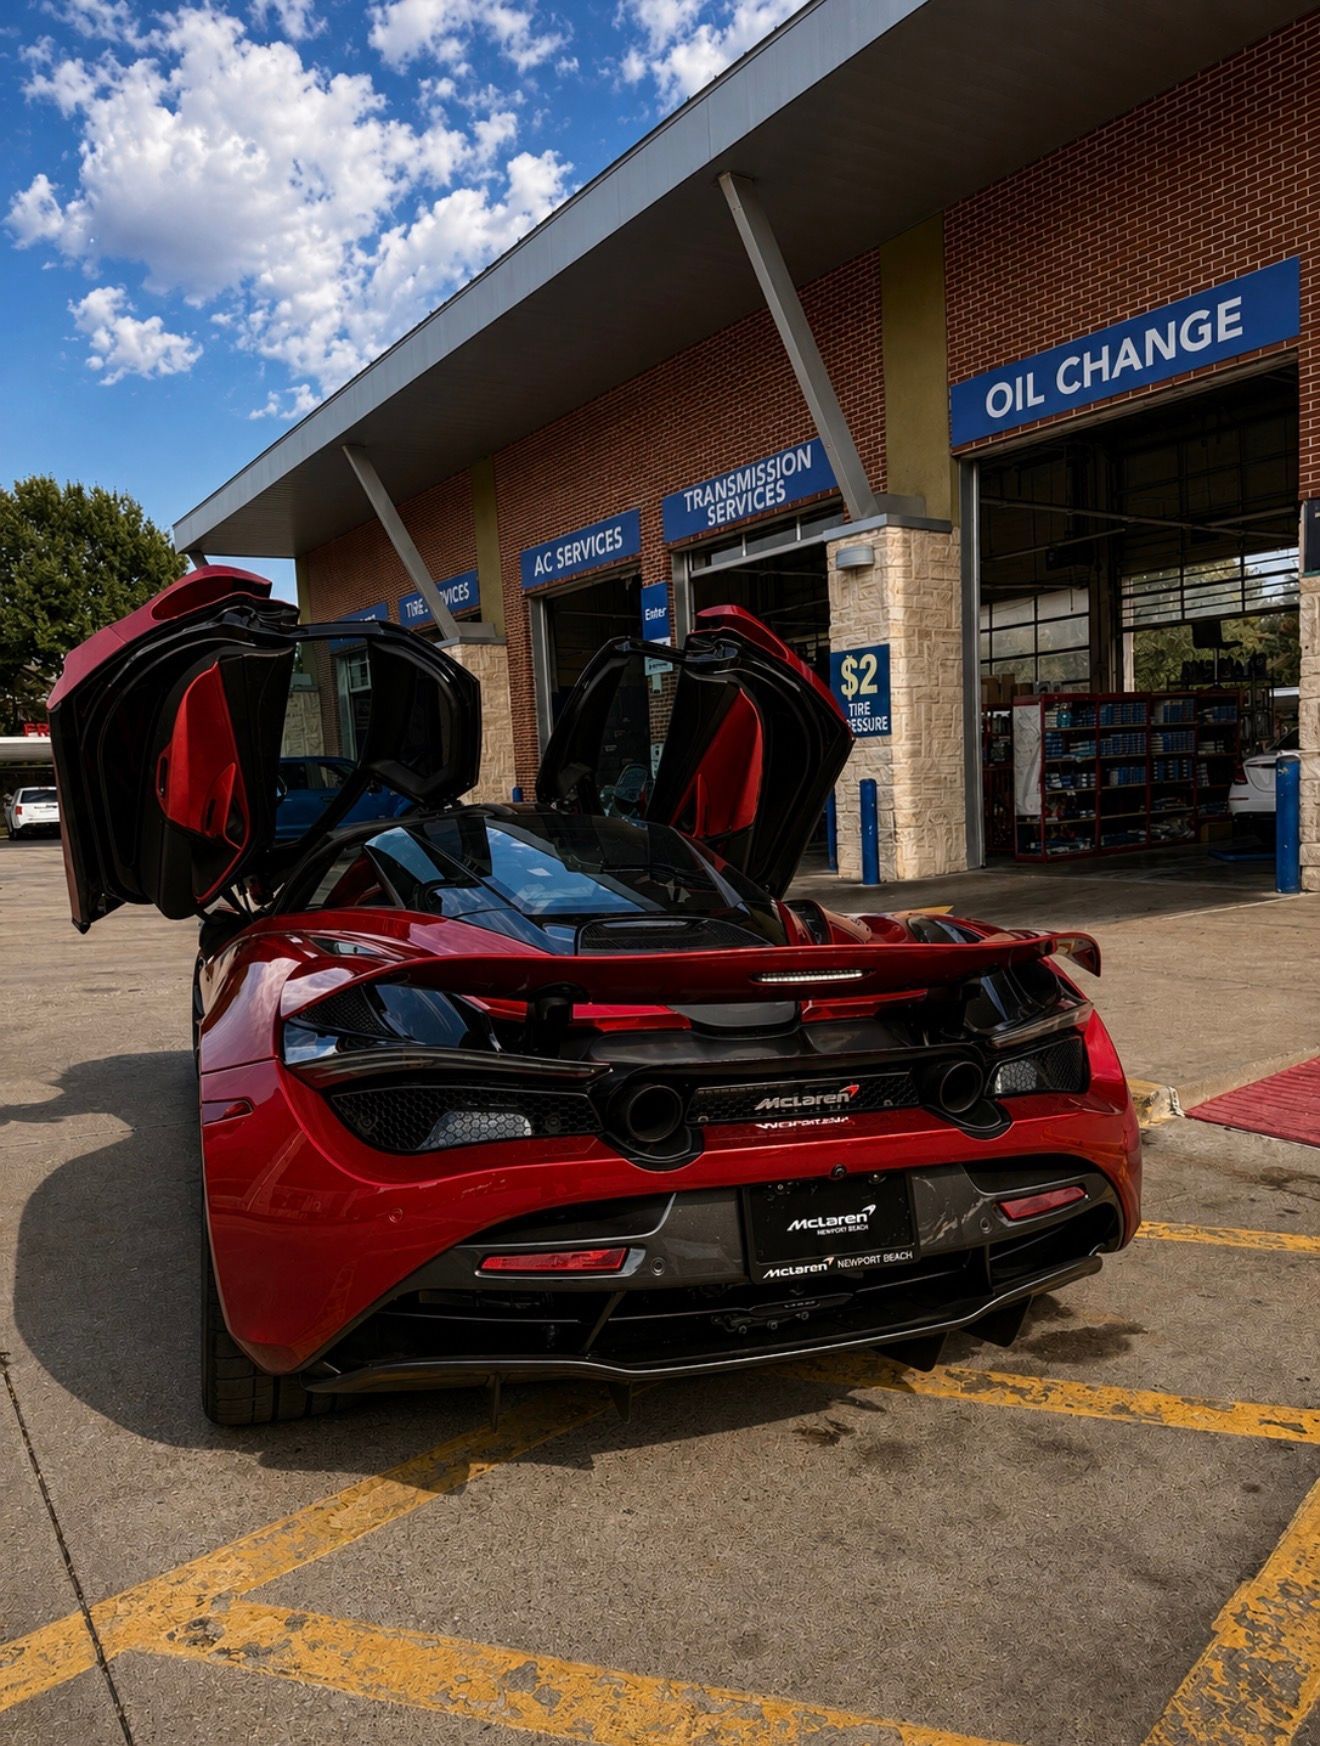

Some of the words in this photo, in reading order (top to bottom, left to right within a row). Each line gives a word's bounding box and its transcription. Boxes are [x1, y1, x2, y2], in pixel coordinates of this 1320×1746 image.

[985, 372, 1045, 418] OIL
[1056, 296, 1243, 395] CHANGE
[684, 445, 812, 512] TRANSMISSION
[707, 480, 786, 527] SERVICES
[534, 553, 553, 577] AC
[556, 526, 623, 569] SERVICES
[405, 597, 424, 618] TIRE
[645, 606, 667, 621] Enter
[840, 655, 878, 701] $2
[848, 701, 871, 717] TIRE
[754, 1093, 850, 1110] McLaren
[786, 1212, 869, 1232] McLaren
[817, 1227, 847, 1236] NEWPORT
[762, 1263, 828, 1279] McLaren
[837, 1255, 881, 1269] NEWPORT
[884, 1251, 913, 1263] BEACH
